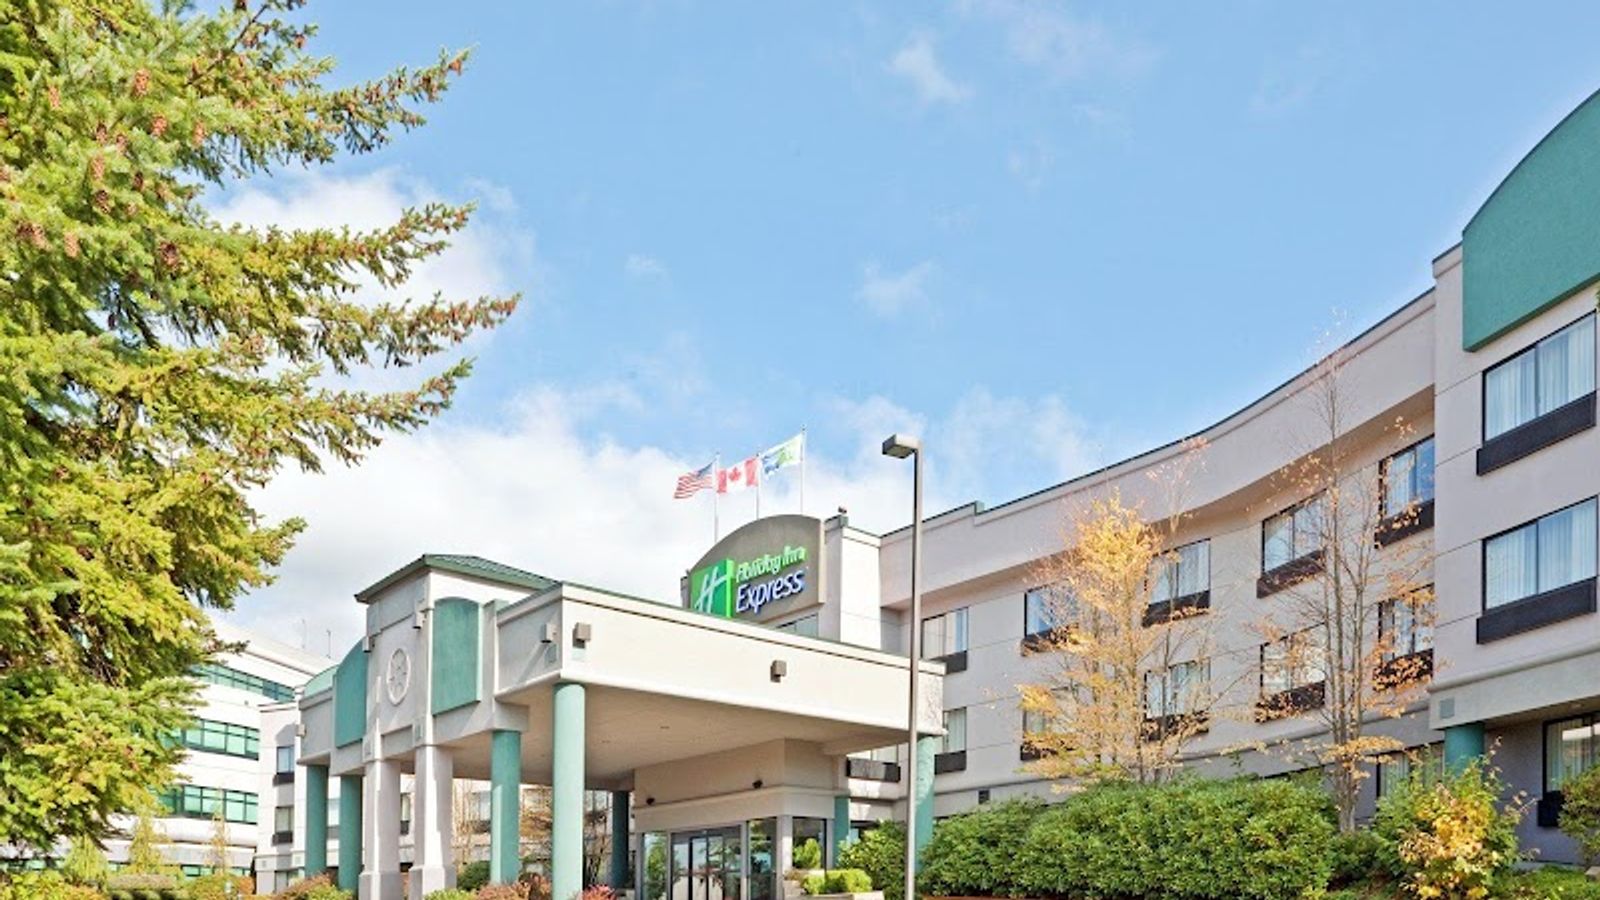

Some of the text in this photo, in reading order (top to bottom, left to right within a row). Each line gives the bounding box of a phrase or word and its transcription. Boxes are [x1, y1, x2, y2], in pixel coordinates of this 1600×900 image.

[736, 546, 807, 583] Holiday Inn
[736, 569, 804, 613] Express
